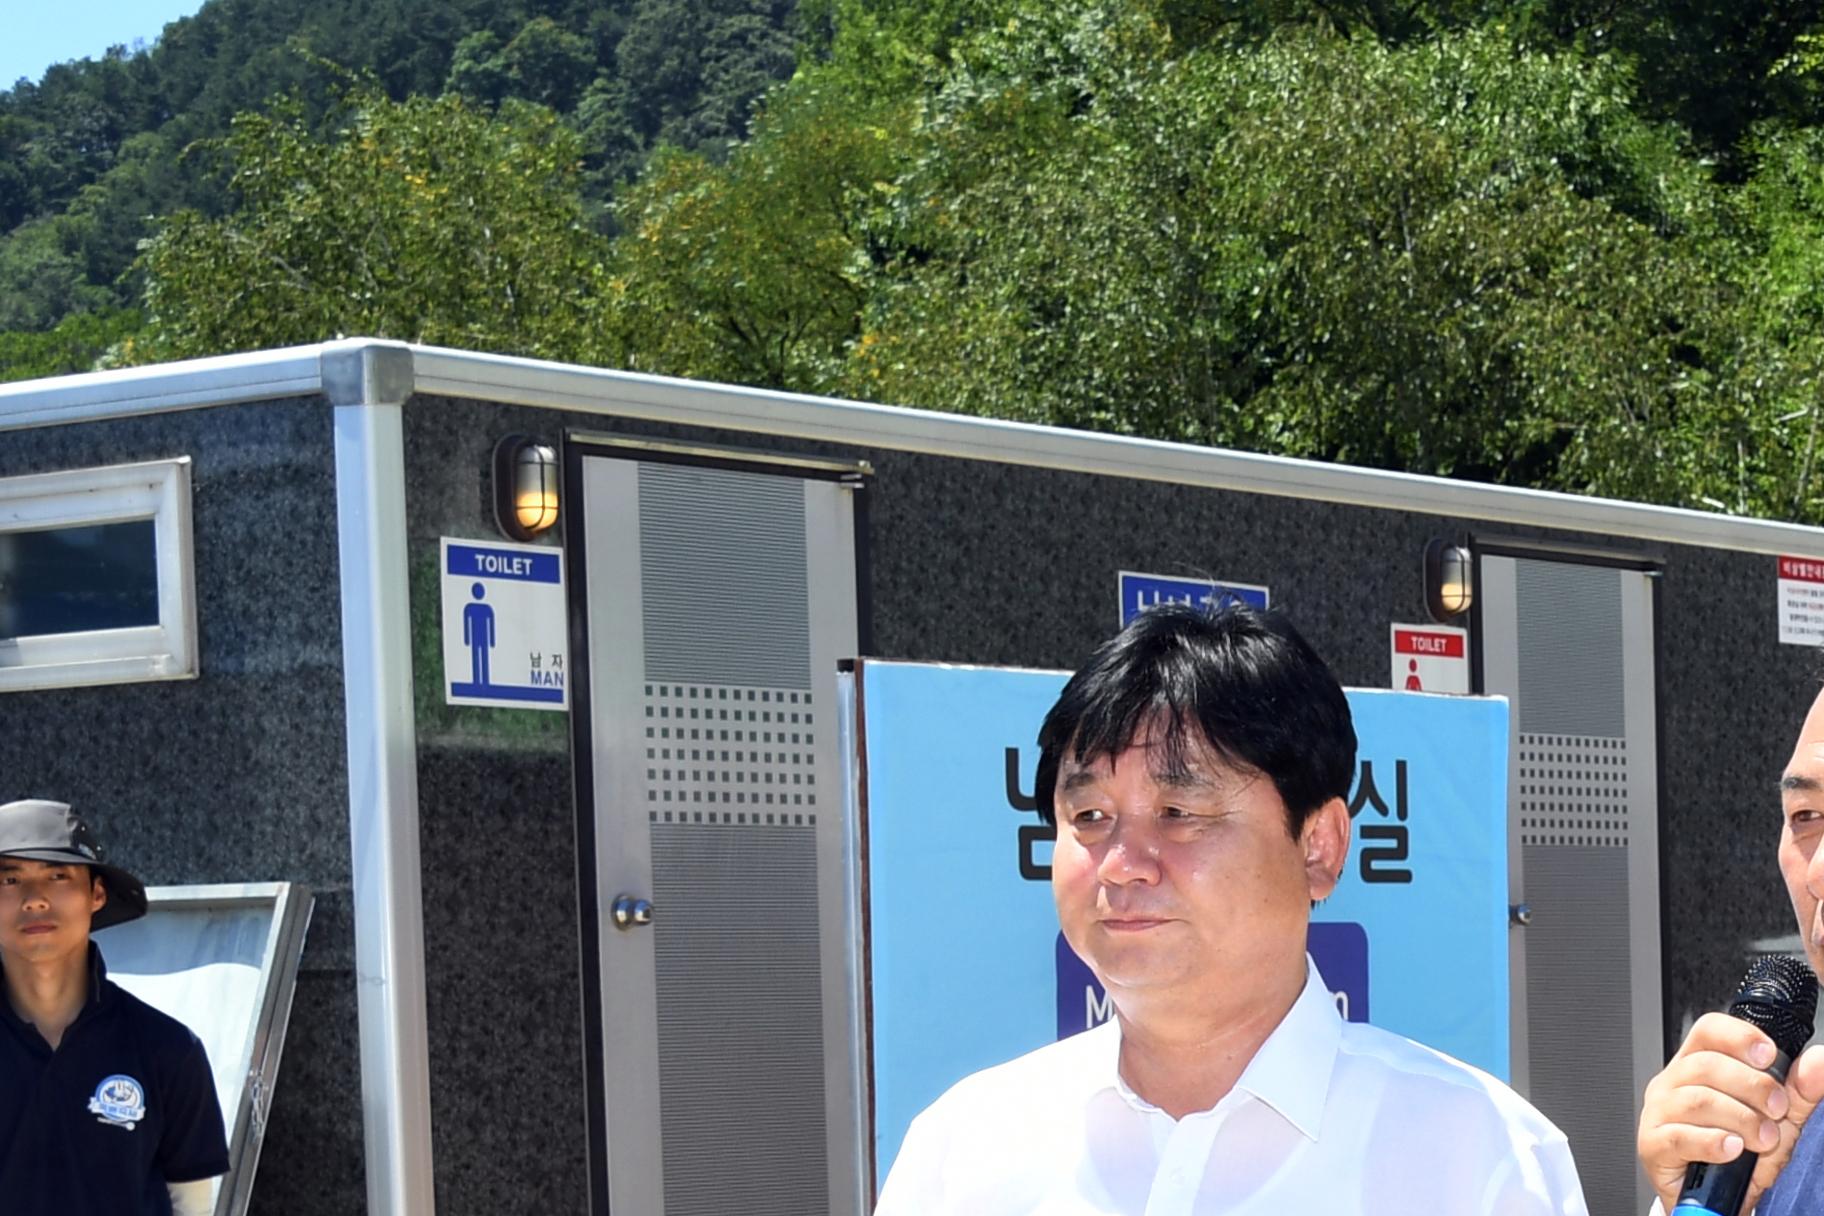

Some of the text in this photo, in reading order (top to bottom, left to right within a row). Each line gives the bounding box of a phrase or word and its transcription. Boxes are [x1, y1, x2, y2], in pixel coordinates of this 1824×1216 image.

[474, 554, 533, 576] TOILET
[1410, 636, 1447, 653] TOILET
[530, 670, 565, 687] MAN
